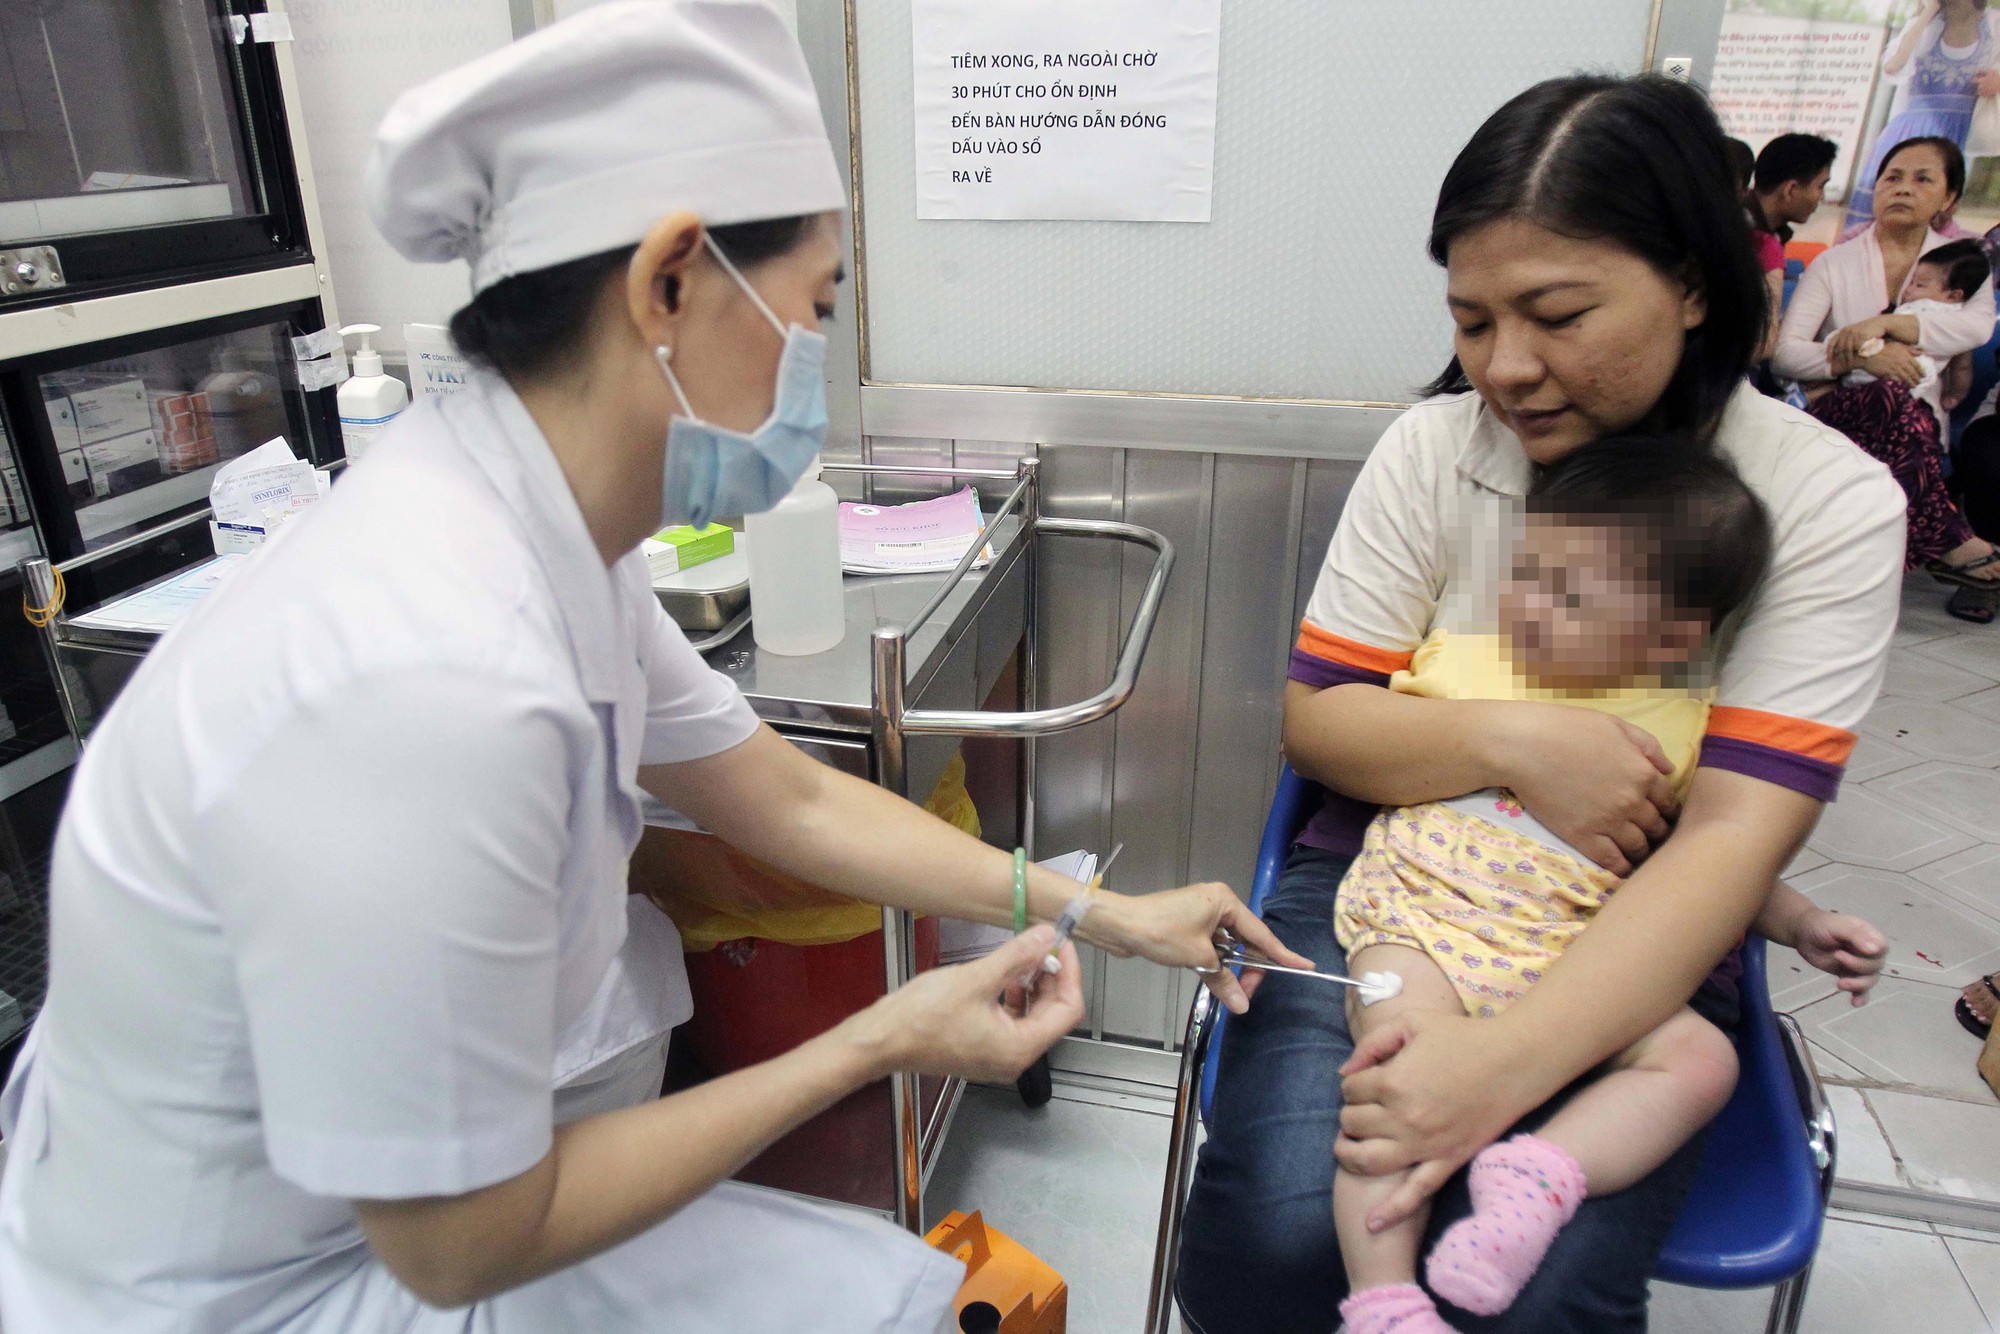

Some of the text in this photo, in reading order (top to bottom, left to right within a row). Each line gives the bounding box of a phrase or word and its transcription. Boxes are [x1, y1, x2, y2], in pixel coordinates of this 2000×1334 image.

[951, 49, 1158, 70] TIÊM XONG, RA NGOÀI CHỜ
[951, 78, 1117, 101] 30 PHÚT CHO ỔN ĐỊNH
[951, 109, 1167, 128] ĐẾN BÀN HƯỚNG DẪN ĐÓNG
[952, 135, 1042, 154] DẤU VÀO SỔ
[952, 165, 992, 183] RA VỀ
[254, 486, 290, 501] SYNFLORIX
